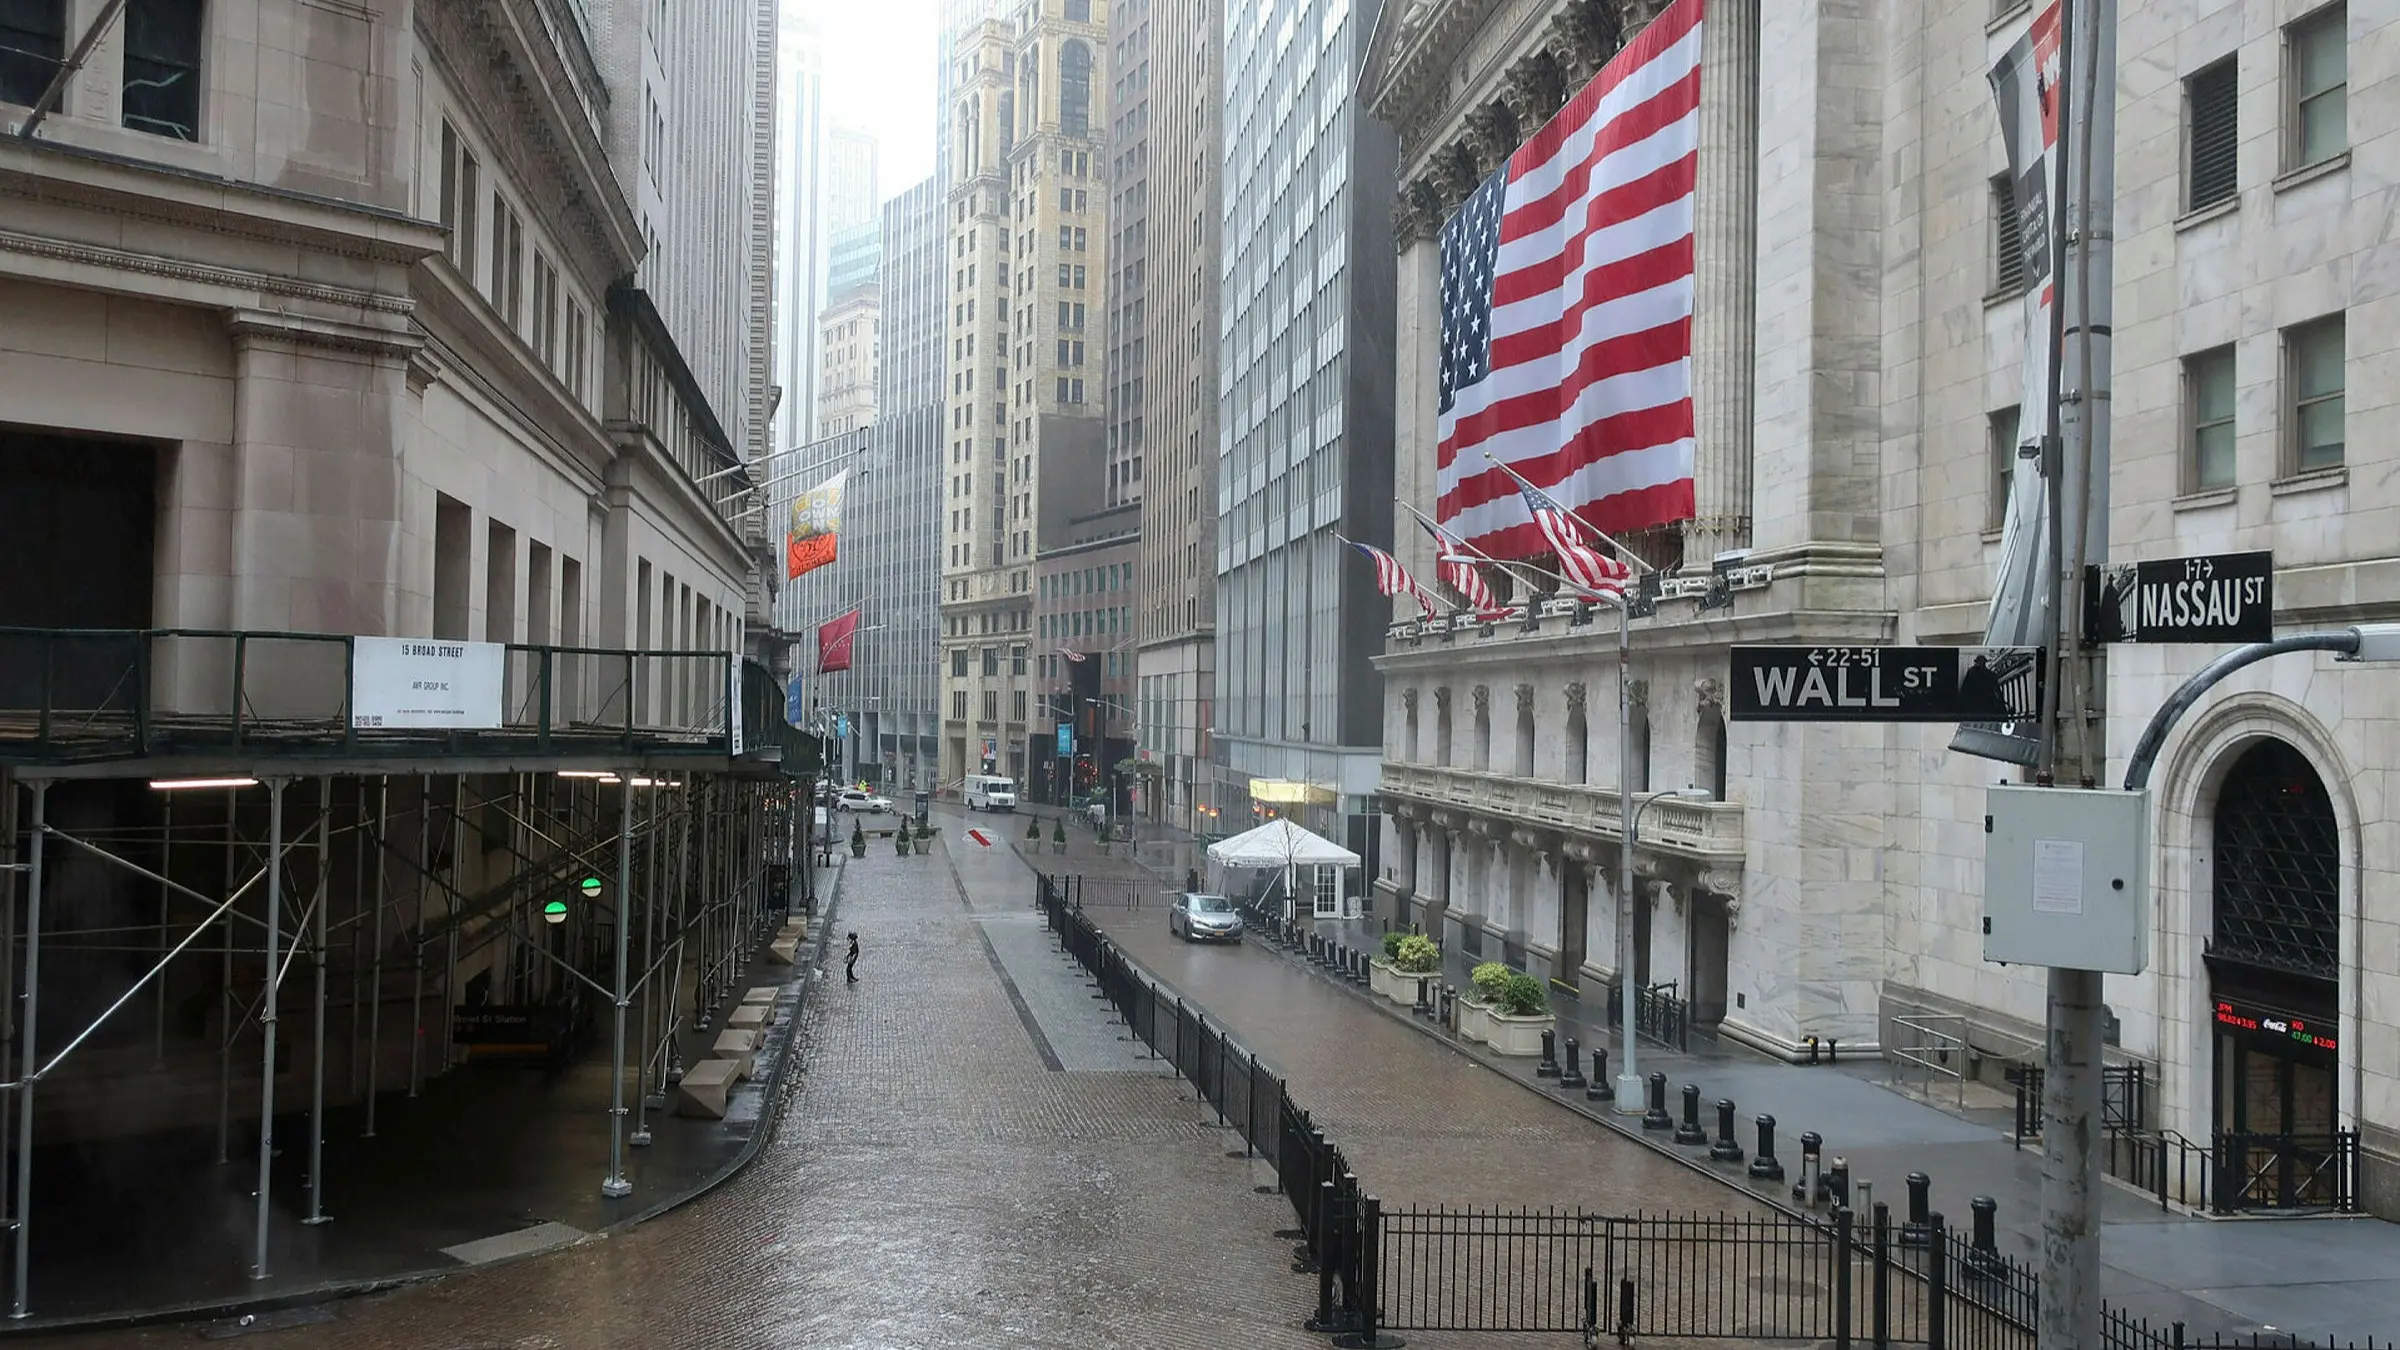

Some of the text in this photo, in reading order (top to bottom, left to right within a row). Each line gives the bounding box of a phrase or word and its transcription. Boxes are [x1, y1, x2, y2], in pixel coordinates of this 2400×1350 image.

[2185, 559, 2201, 580] 1-7
[2142, 576, 2265, 627] NASSAU ST
[402, 644, 464, 658] 15 BROAD STREET
[1827, 648, 1880, 667] 22-51
[1753, 666, 1938, 707] WALL ST
